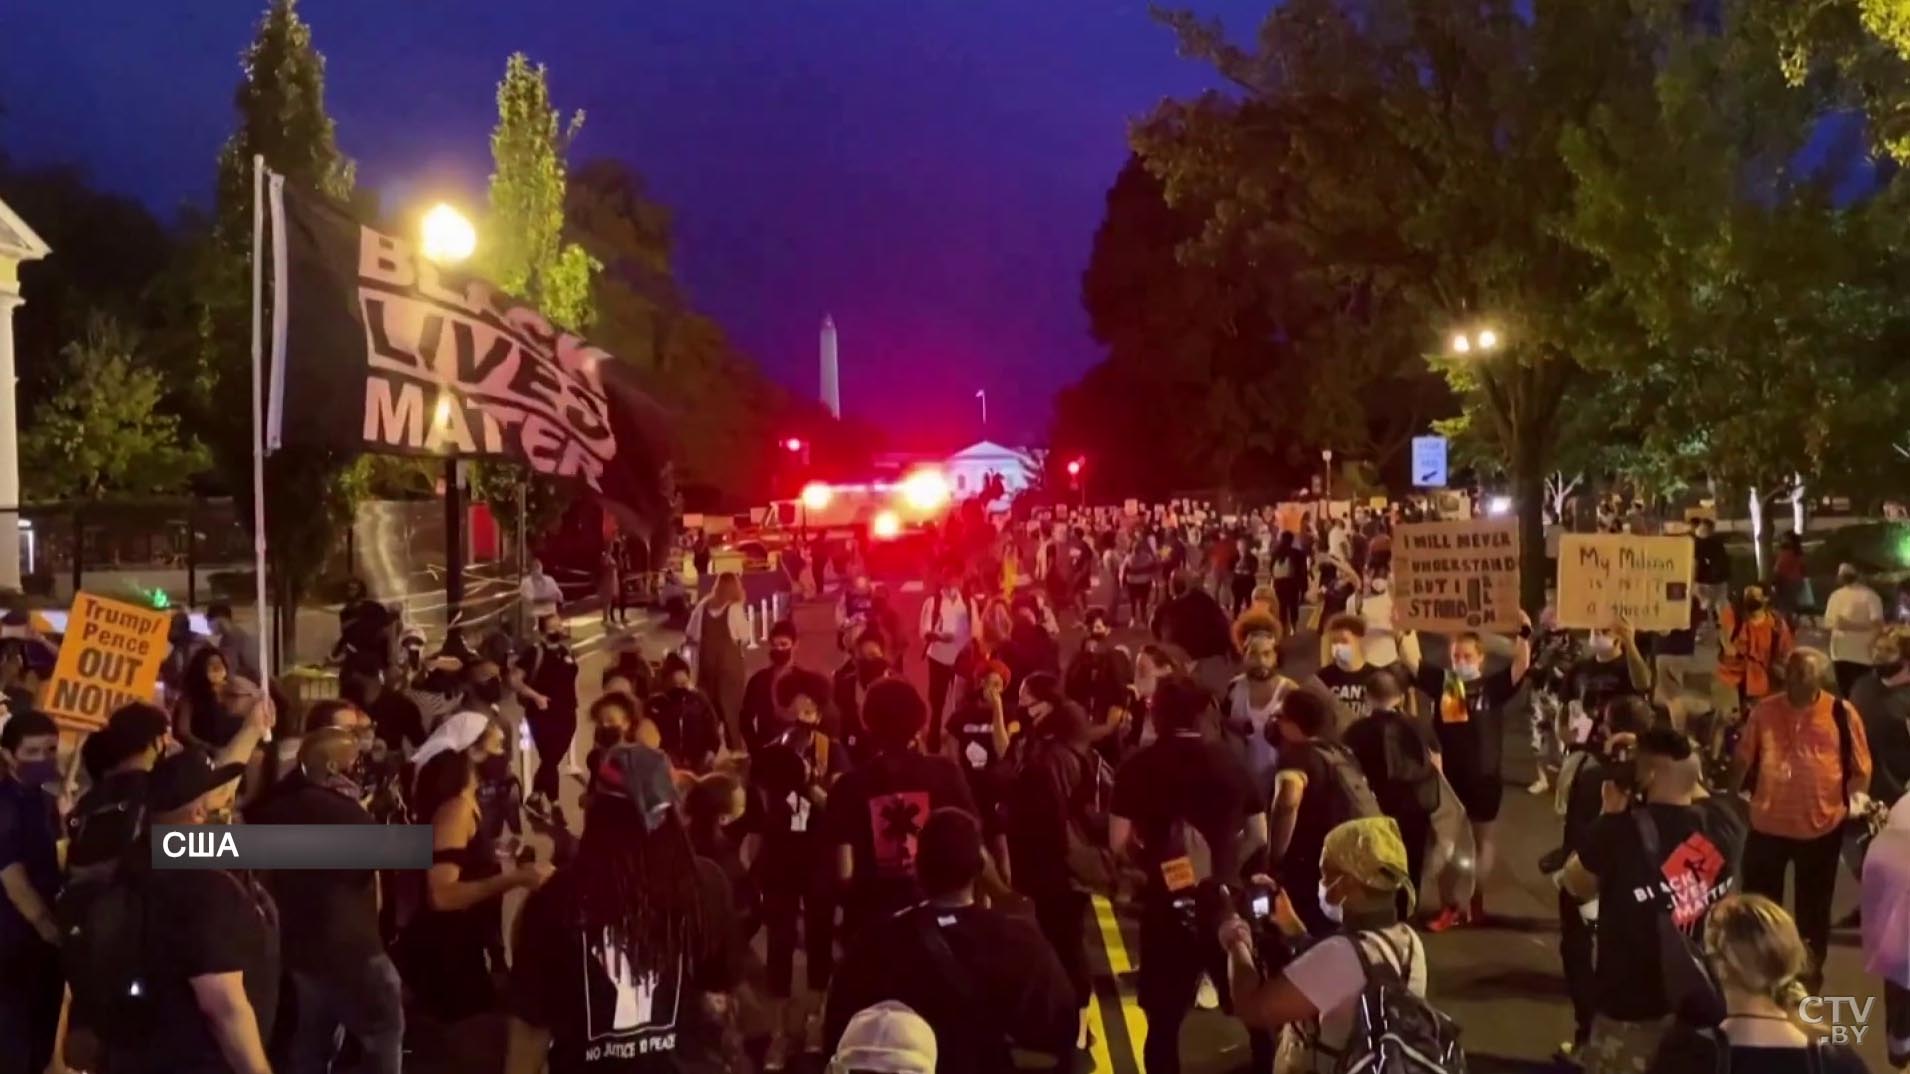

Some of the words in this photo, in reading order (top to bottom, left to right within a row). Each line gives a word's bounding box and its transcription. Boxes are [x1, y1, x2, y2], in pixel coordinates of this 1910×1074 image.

[364, 297, 610, 441] LIVES
[1579, 546, 1610, 577] My
[1414, 578, 1447, 594] BUT
[84, 599, 163, 634] Trump/
[82, 622, 150, 655] Pence
[77, 647, 143, 687] OUT
[585, 1045, 601, 1061] NO
